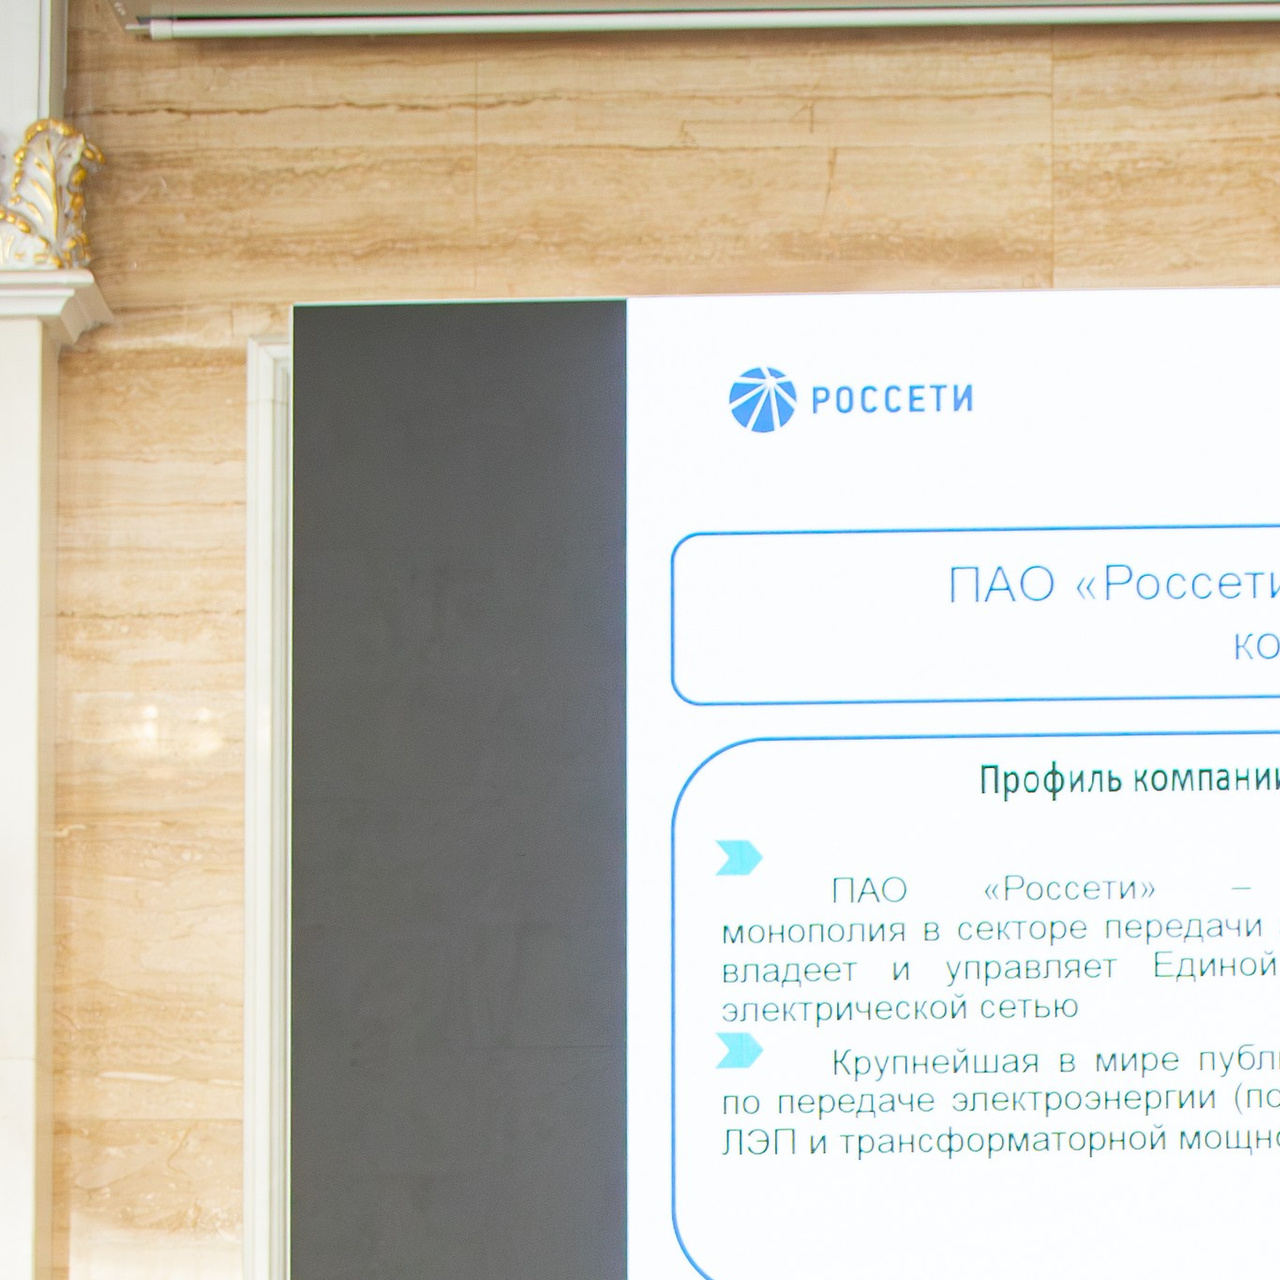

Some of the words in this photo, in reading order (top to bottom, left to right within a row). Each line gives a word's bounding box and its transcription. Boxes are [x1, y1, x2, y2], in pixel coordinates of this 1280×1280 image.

[811, 382, 974, 415] РОССЕТИ
[950, 563, 1056, 604] ПАО
[980, 759, 1124, 803] Профиль
[832, 875, 908, 904] ПАО
[983, 873, 1156, 902] «Россети»
[722, 921, 906, 945] монополия
[923, 920, 941, 942] в
[957, 919, 1088, 947] секторе
[1104, 917, 1263, 946] передачи
[722, 961, 859, 989] владеет
[891, 960, 910, 982] и
[945, 957, 1119, 988] управляет
[1154, 949, 1277, 983] Единой
[721, 992, 968, 1029] электрической
[979, 997, 1079, 1020] сетью
[832, 1047, 1040, 1083] Крупнейшая
[1058, 1051, 1077, 1073] в
[1095, 1051, 1180, 1079] мире
[722, 1094, 761, 1115] по
[777, 1092, 936, 1121] передаче
[951, 1087, 1216, 1118] электроэнергии
[721, 1127, 797, 1156] ЛЭП
[808, 1133, 828, 1155] и
[839, 1123, 1167, 1161] трансформаторной
